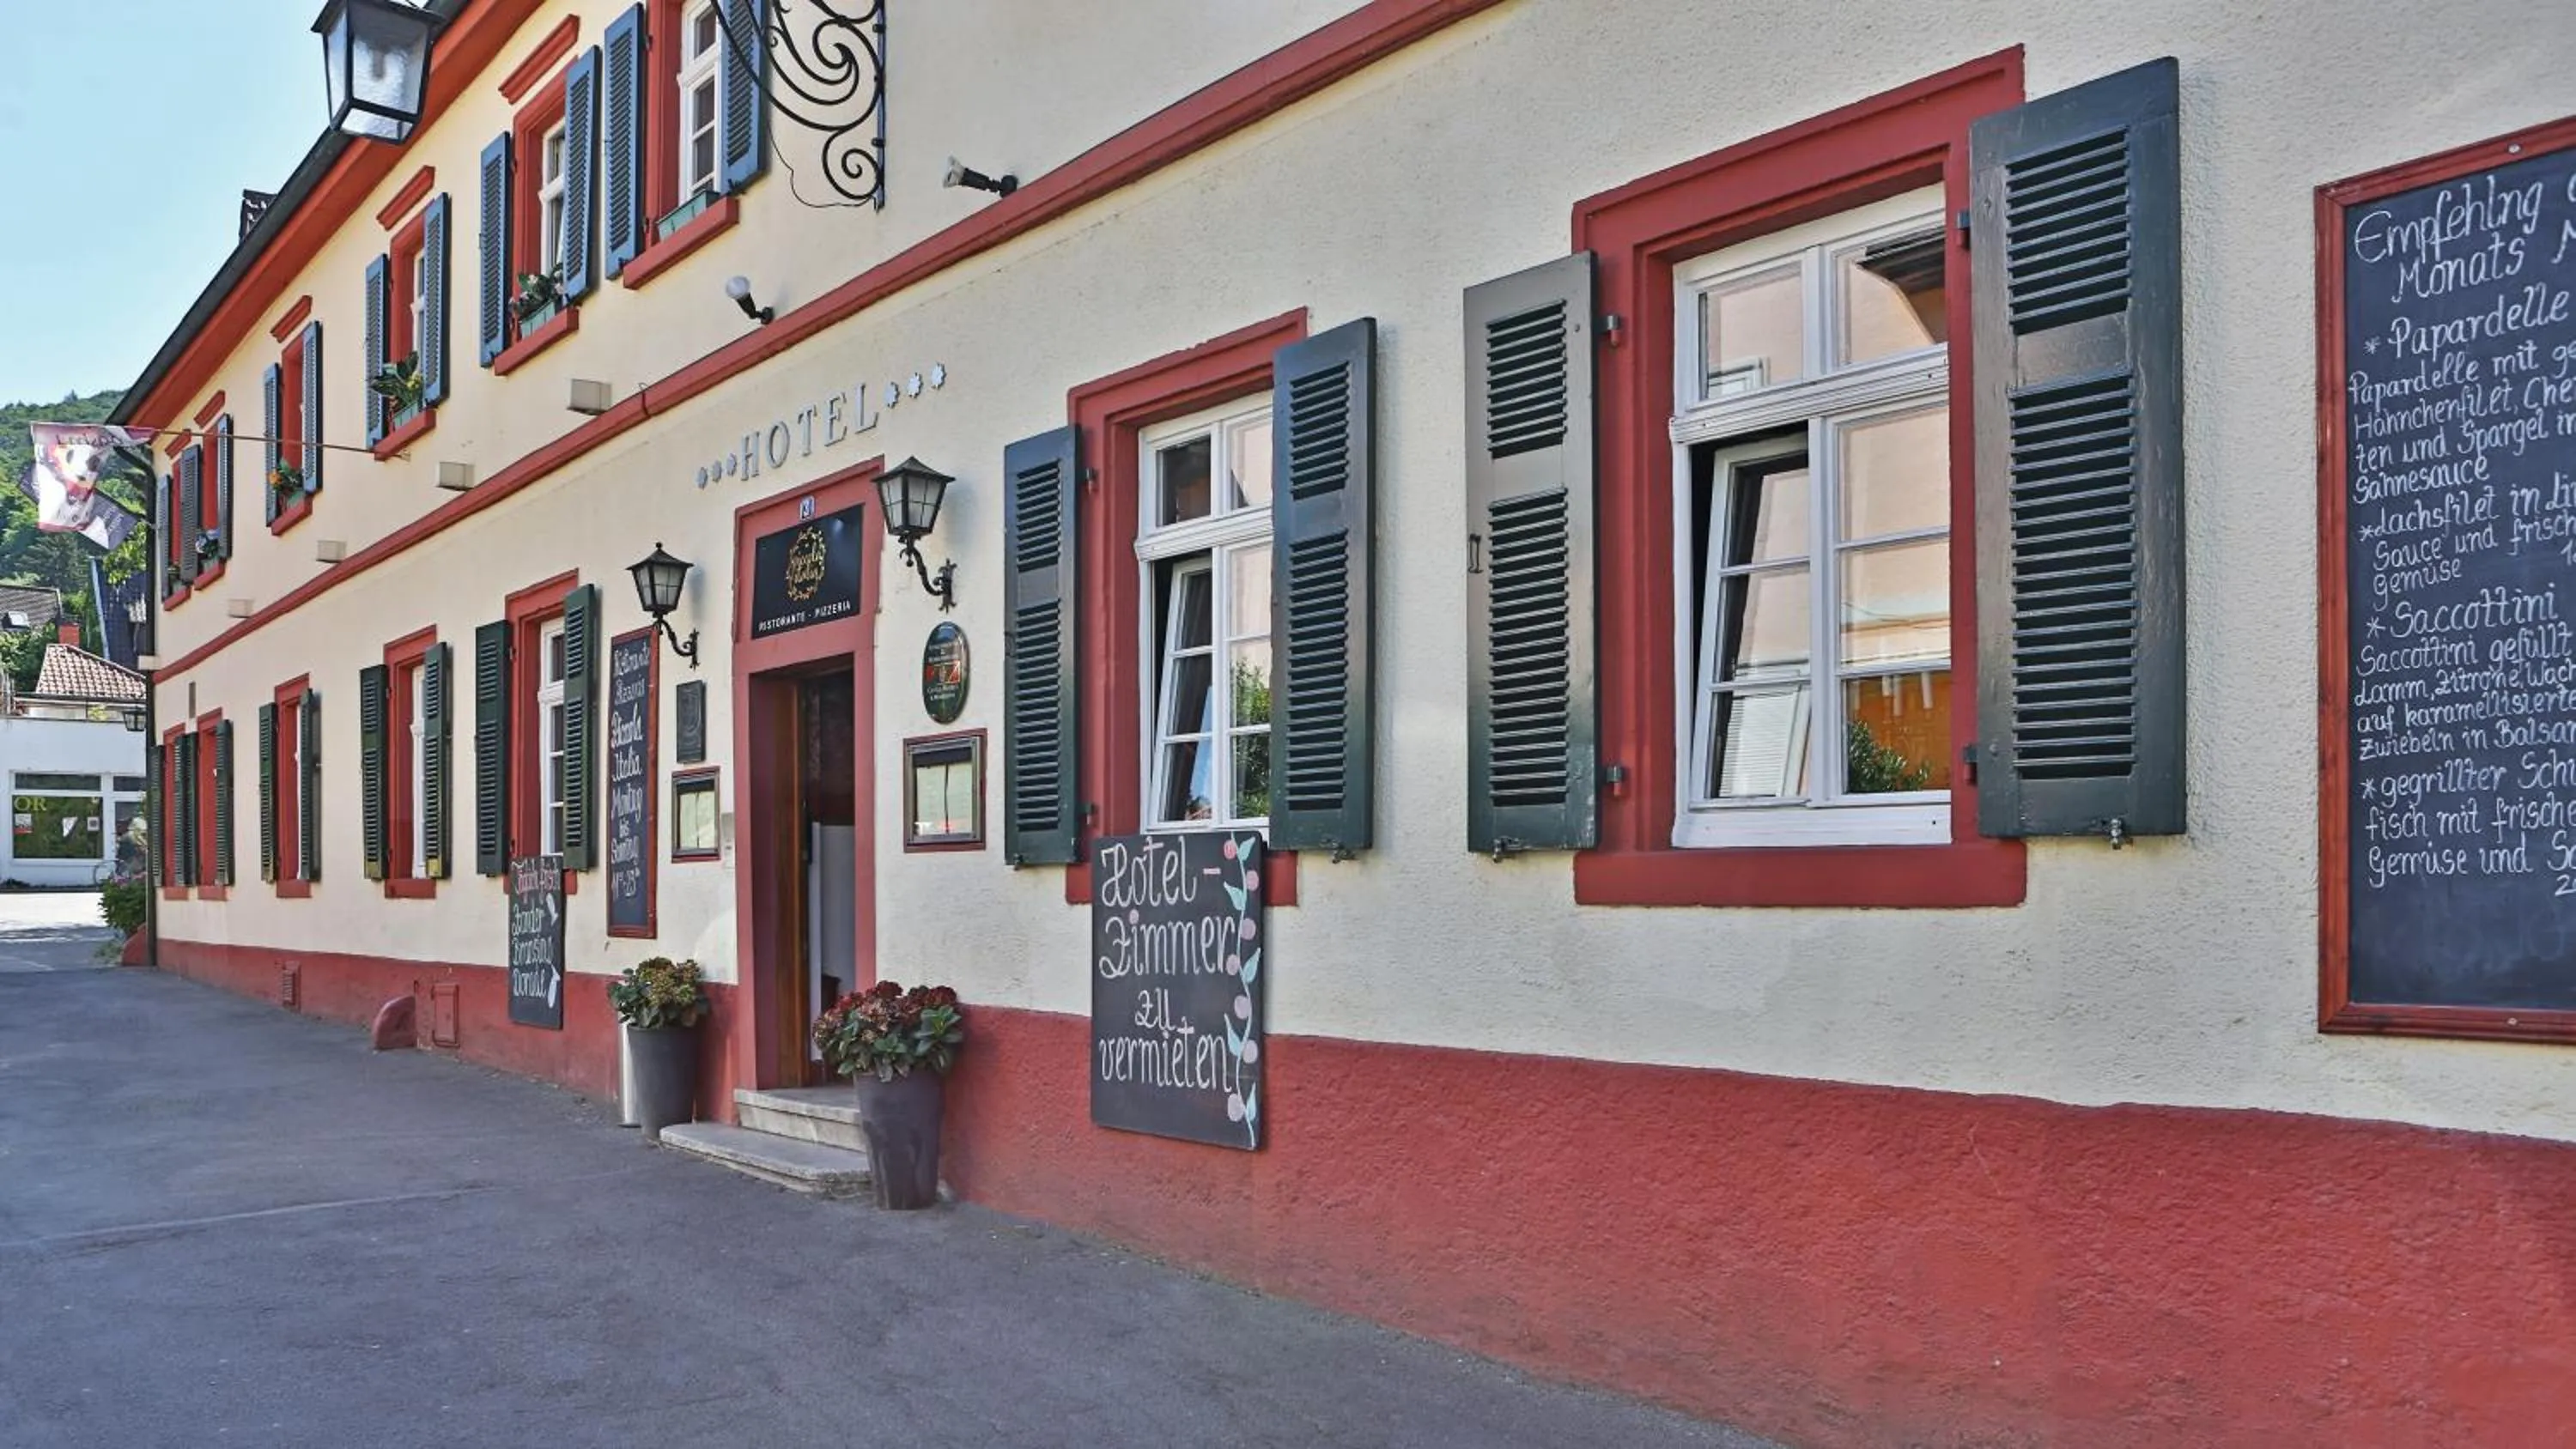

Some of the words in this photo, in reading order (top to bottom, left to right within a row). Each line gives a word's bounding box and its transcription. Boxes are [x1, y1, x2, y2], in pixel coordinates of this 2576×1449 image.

[2391, 231, 2526, 303] Monats
[2387, 282, 2570, 362] Papardelle
[2348, 350, 2481, 413] Papardelle
[2492, 339, 2540, 376] mit
[739, 383, 879, 481] HOTEL
[2355, 444, 2393, 474] ten
[2403, 426, 2451, 464] und
[2458, 407, 2549, 456] Spargel
[2353, 456, 2490, 504] Sahnesauce
[2509, 484, 2541, 516] in
[2373, 540, 2444, 571] Sauce
[2455, 521, 2499, 554] und
[814, 600, 851, 619] PIZZERIA
[2390, 582, 2559, 638] Saccottini
[2356, 634, 2479, 676] Saccottini
[2489, 621, 2573, 673] gefüllt
[2357, 706, 2395, 738] auf
[2360, 727, 2454, 761] Zwiebeln
[2462, 728, 2488, 750] in
[2381, 757, 2507, 808] gegrillter
[2366, 800, 2429, 841] fisch
[2436, 797, 2482, 835] mit
[2479, 832, 2535, 875] und
[1099, 909, 1236, 979] Zimmer
[1099, 1016, 1233, 1092] vermieten
